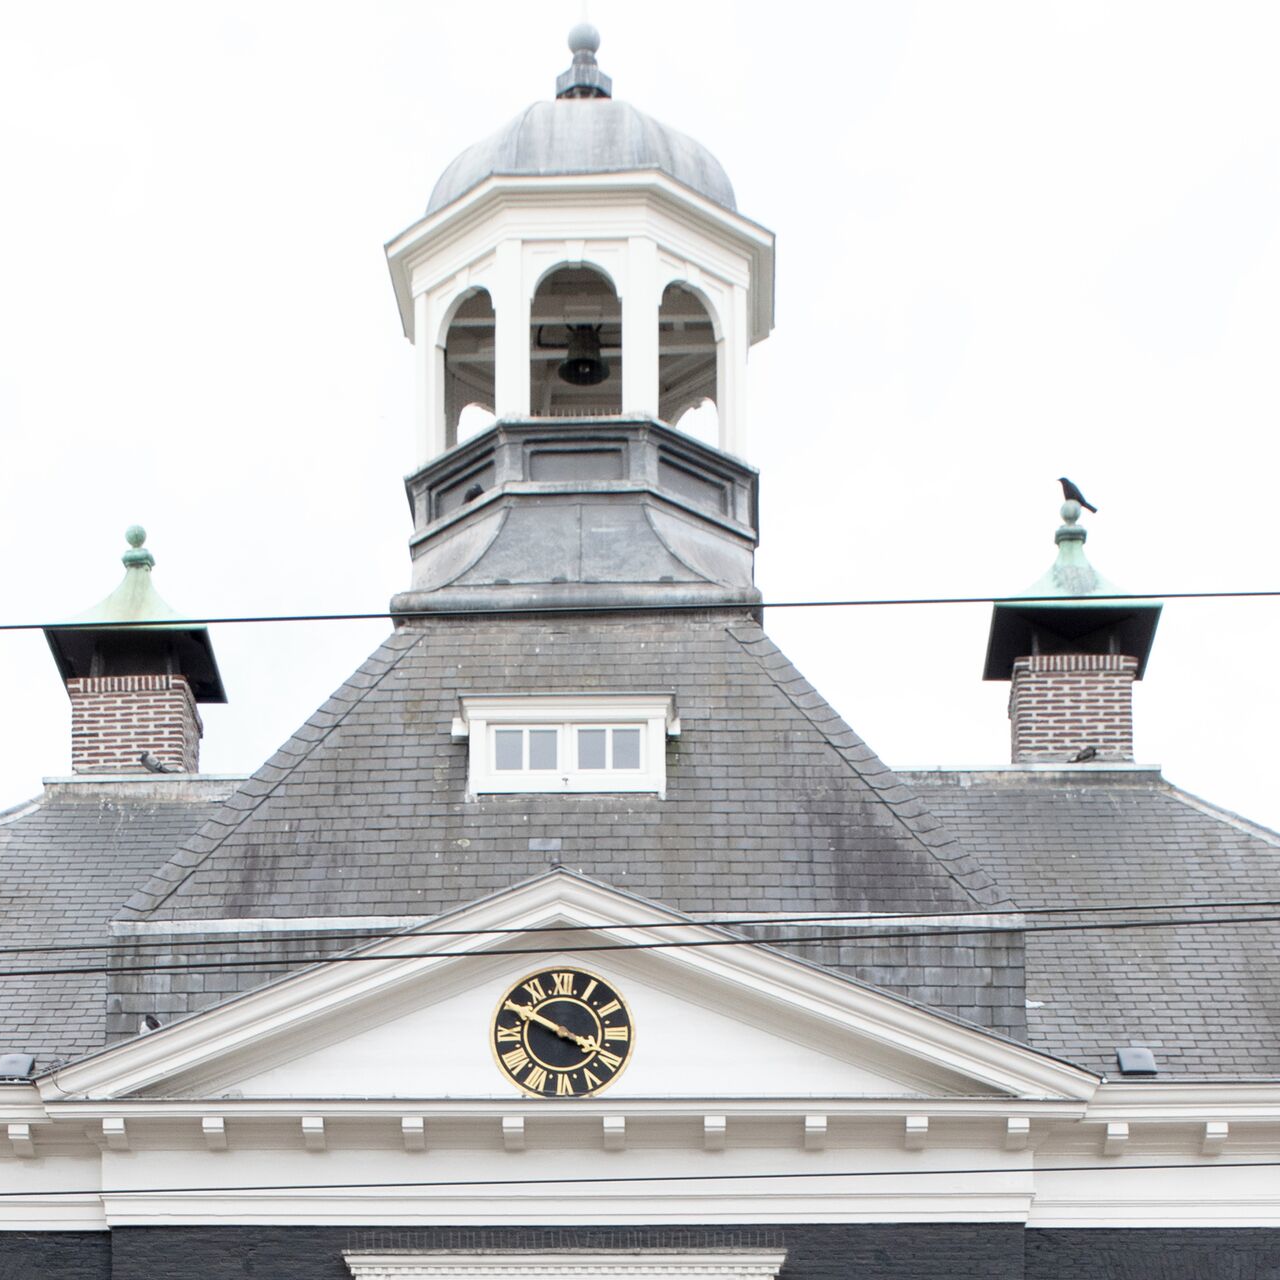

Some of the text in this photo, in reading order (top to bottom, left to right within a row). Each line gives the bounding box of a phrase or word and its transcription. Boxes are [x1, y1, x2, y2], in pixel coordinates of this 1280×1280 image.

[522, 978, 547, 1004] XI
[551, 973, 575, 995] XII
[580, 979, 598, 1001] I
[597, 998, 621, 1018] II
[497, 1025, 522, 1042] IX
[604, 1026, 628, 1041] III
[502, 1048, 530, 1076] VIII
[523, 1065, 547, 1092] VII
[556, 1073, 574, 1096] VI
[583, 1068, 602, 1089] V
